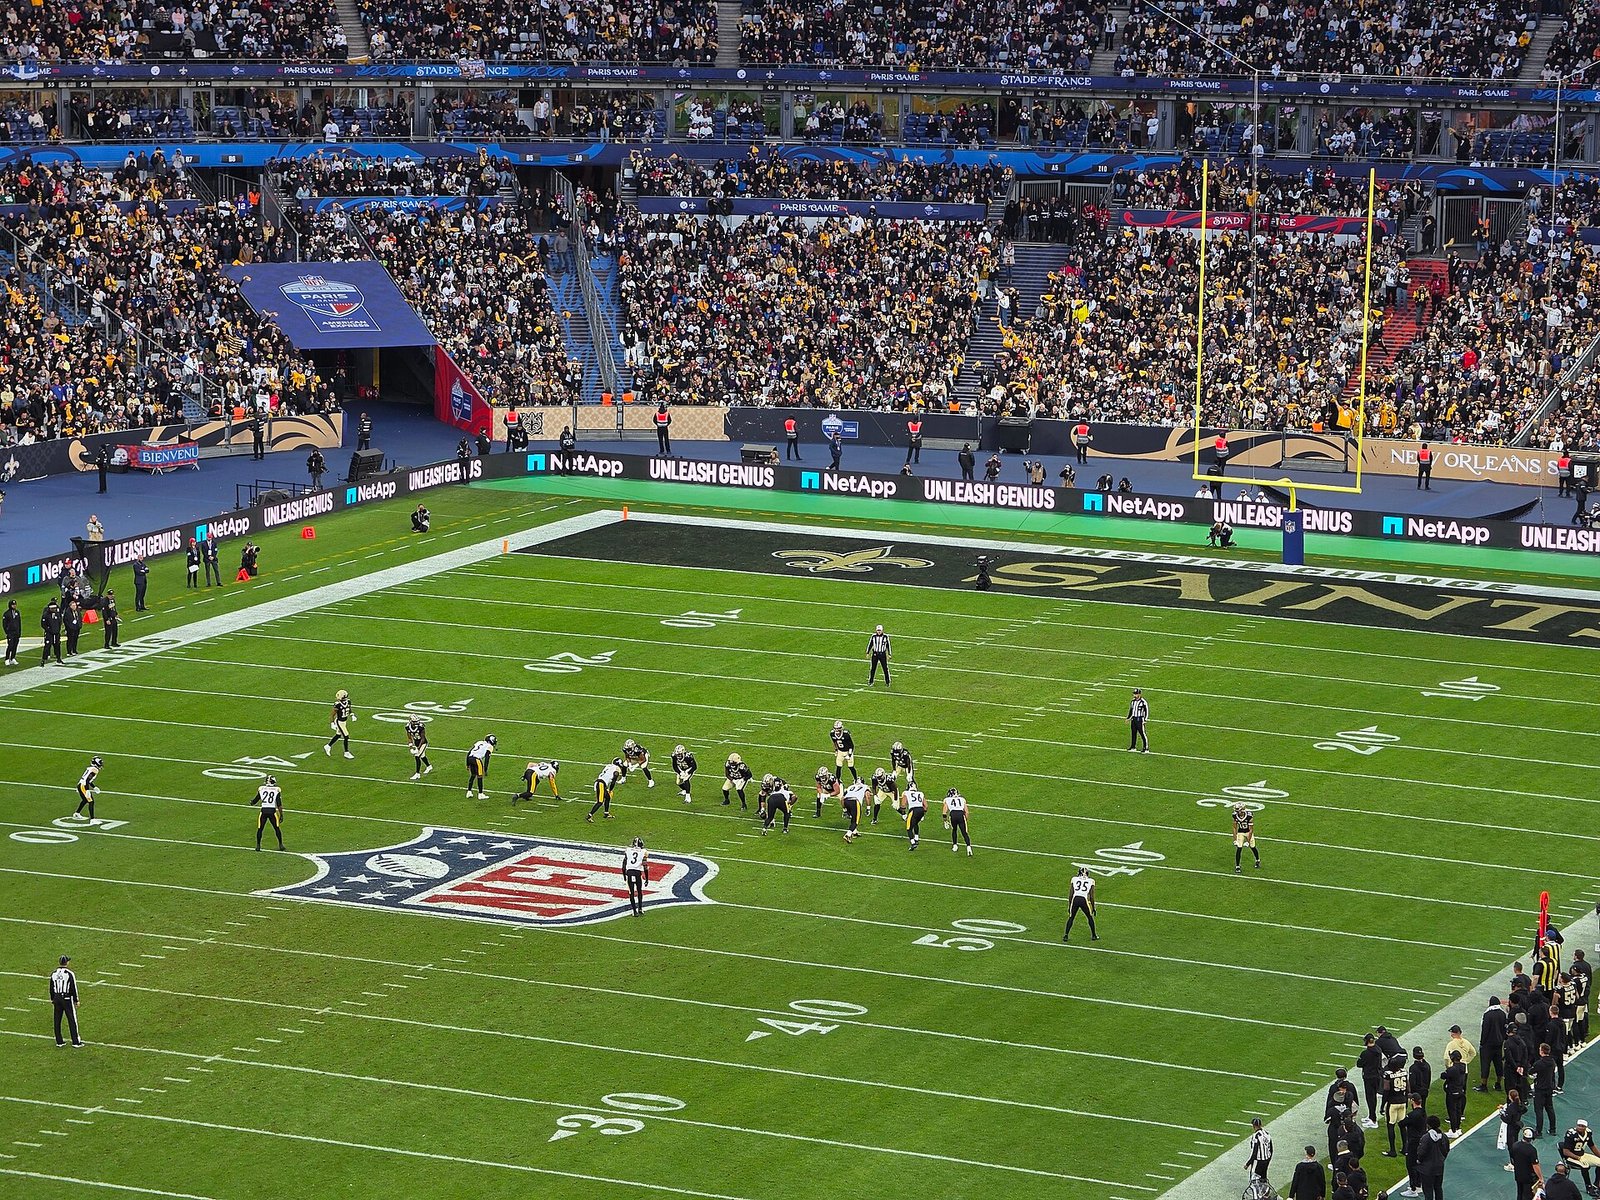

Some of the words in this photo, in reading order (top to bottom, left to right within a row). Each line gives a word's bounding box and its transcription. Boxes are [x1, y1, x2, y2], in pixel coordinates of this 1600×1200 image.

[284, 66, 307, 74] PARIS
[307, 66, 334, 74] GAME
[416, 66, 455, 76] STADE
[870, 73, 893, 81] PARIS
[894, 73, 920, 81] GAME
[1001, 75, 1037, 85] STADE
[1048, 77, 1092, 87] FRANCE
[1194, 81, 1220, 89] GAME
[807, 204, 839, 212] GAME
[650, 458, 717, 484] UNLEASH
[718, 464, 775, 487] GENIUS
[1444, 452, 1541, 475] ORLEANS
[409, 465, 445, 491] UNLEASH
[823, 472, 897, 498] NetApp
[358, 481, 396, 502] NetApp
[924, 479, 994, 505] UNLEASH
[996, 485, 1055, 509] GENIUS
[264, 499, 303, 527] UNLEASH
[302, 492, 334, 518] GENIUS
[1107, 494, 1184, 520] NetApp
[1302, 508, 1353, 533] ENIUS
[1408, 517, 1490, 545] NetApp
[146, 530, 182, 557] GENIUS
[1055, 548, 1268, 570] INSPIRE
[1291, 567, 1517, 592] CHANGE
[1419, 678, 1500, 701] 10
[1313, 728, 1400, 756] 20
[262, 790, 275, 804] 28
[911, 793, 922, 804] 56
[951, 799, 962, 808] 41
[630, 847, 638, 861] 3
[1071, 847, 1165, 877] 40
[421, 855, 672, 918] NFL
[1075, 880, 1088, 893] 35
[911, 918, 1027, 951] 50
[1564, 991, 1576, 1005] 55
[757, 999, 868, 1036] 40
[557, 1092, 687, 1136] 30
